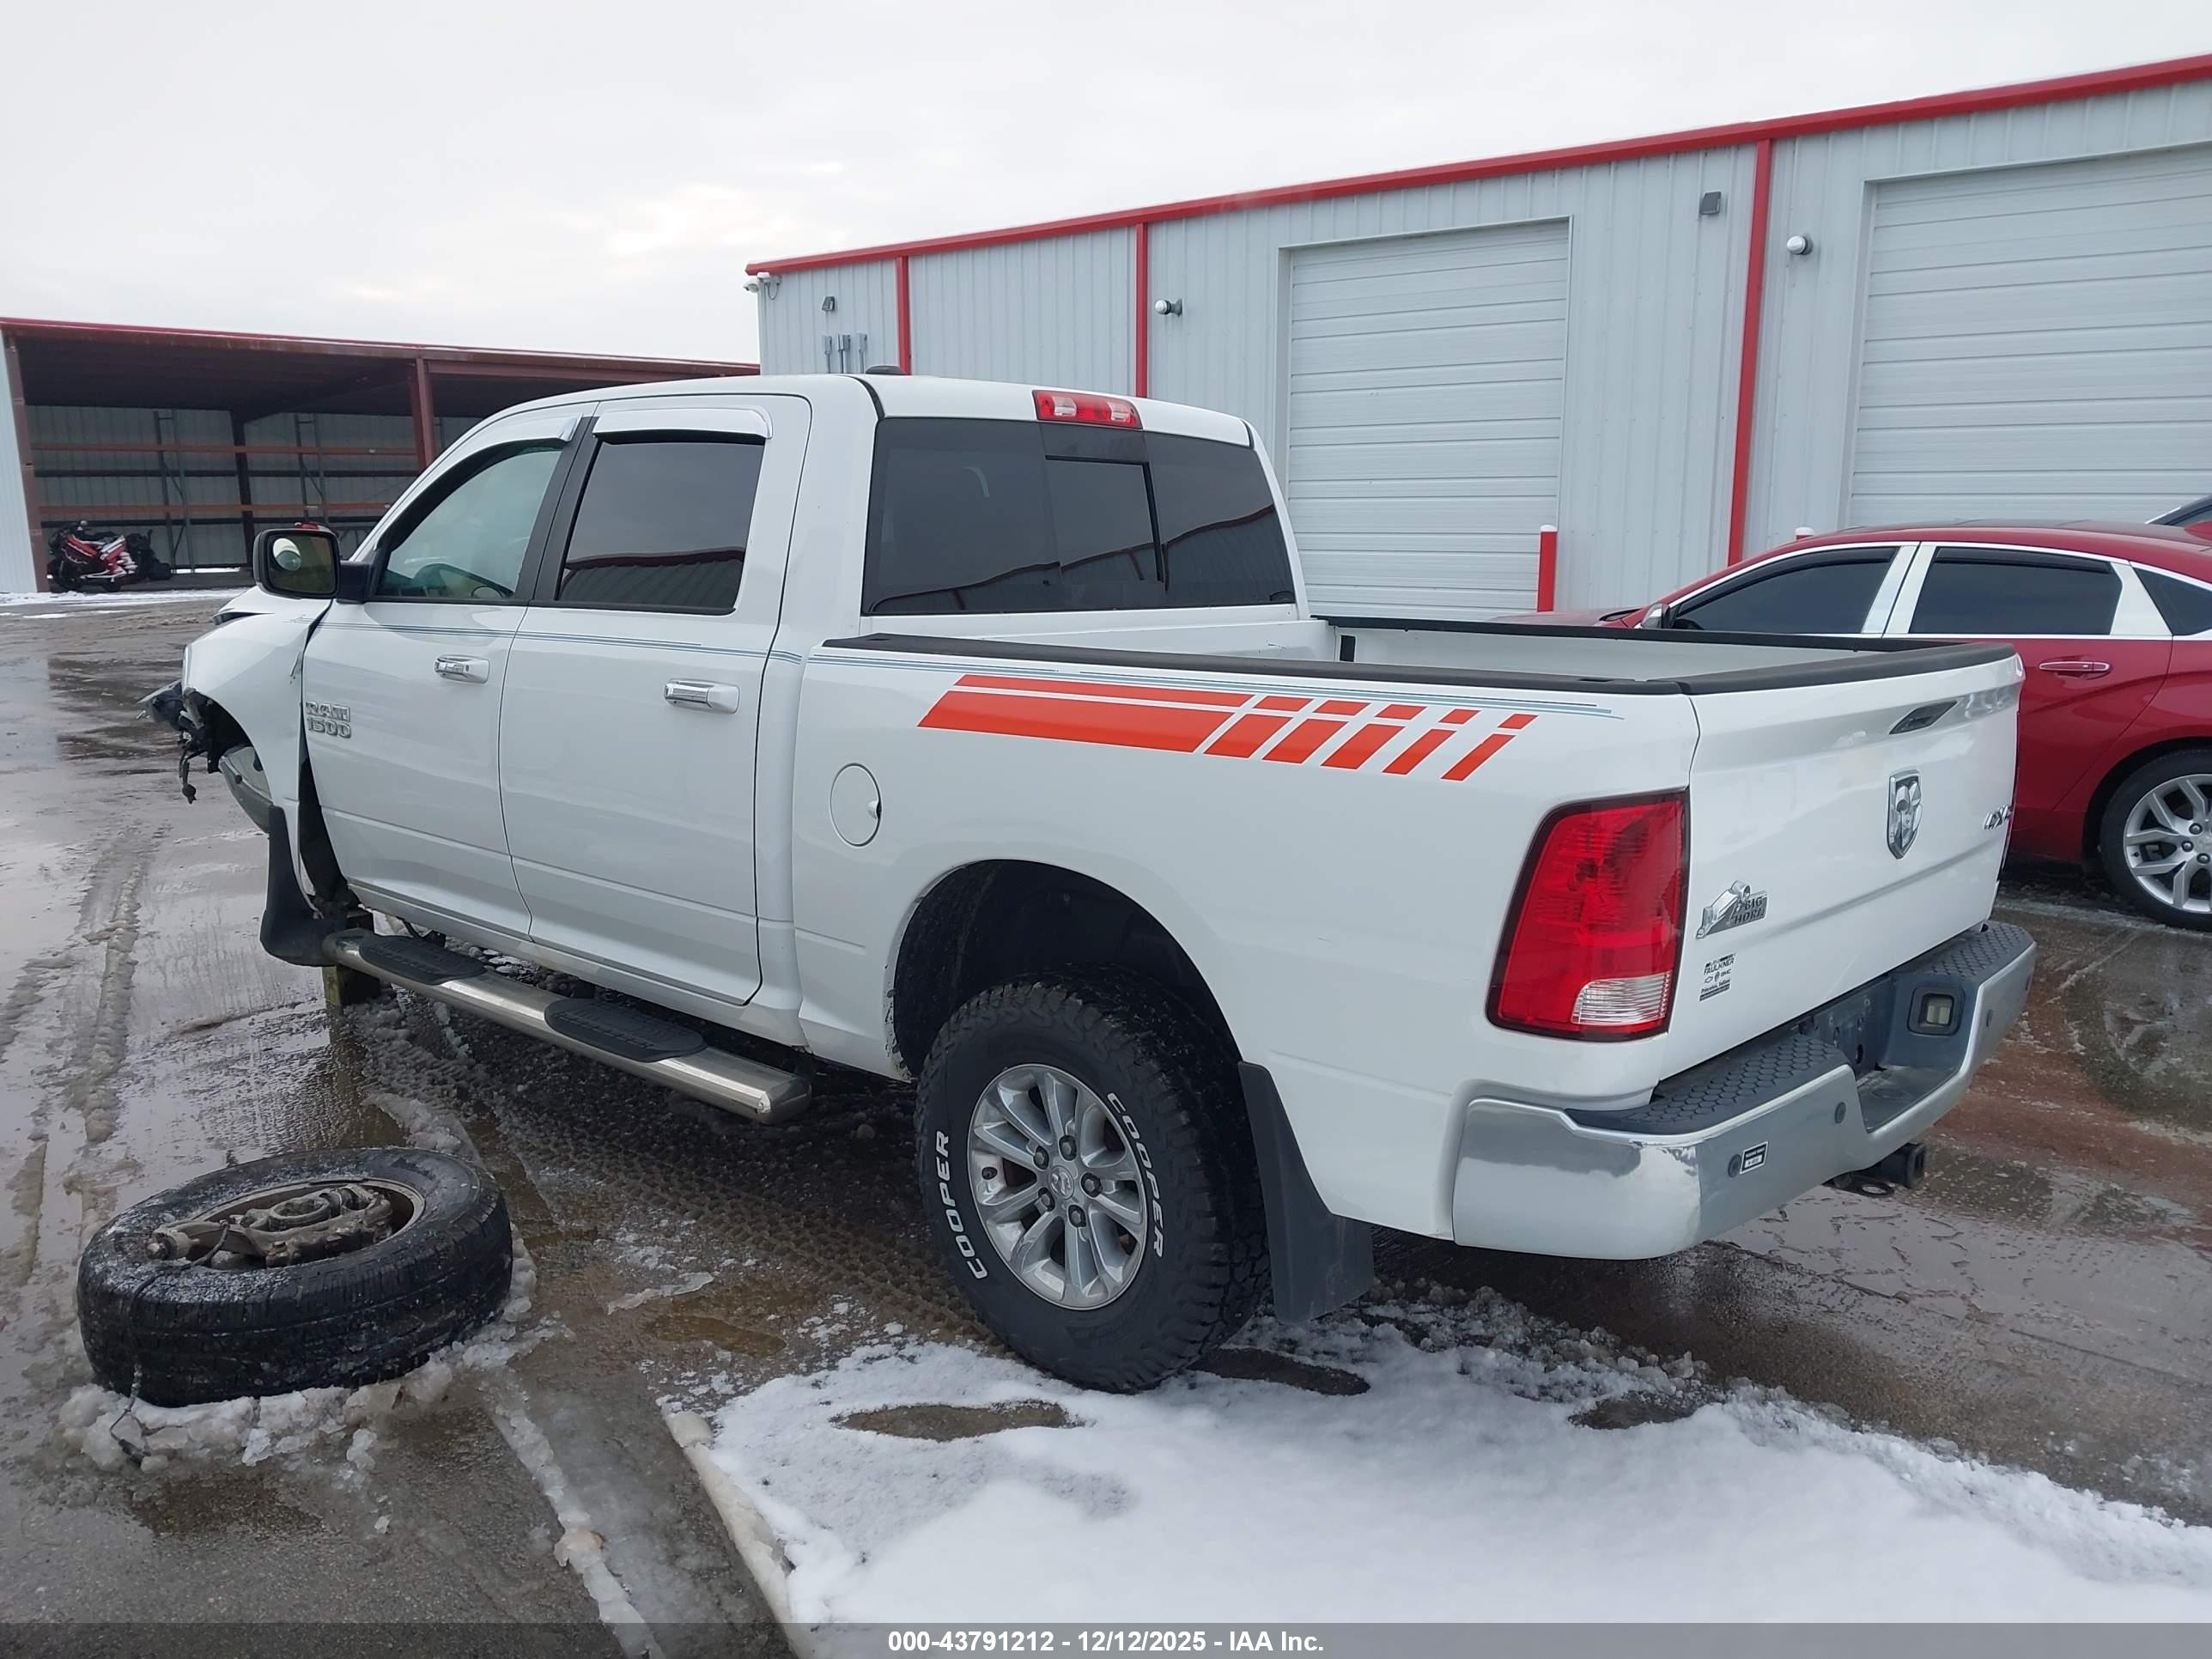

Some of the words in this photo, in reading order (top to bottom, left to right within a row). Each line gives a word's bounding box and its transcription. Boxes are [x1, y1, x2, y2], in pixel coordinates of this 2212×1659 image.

[306, 702, 351, 722] RAM
[307, 716, 352, 738] 1500
[1744, 896, 1763, 910] BIG
[1734, 906, 1765, 925] HORN
[1107, 1092, 1164, 1257] COOPER
[936, 1130, 988, 1279] COOPER
